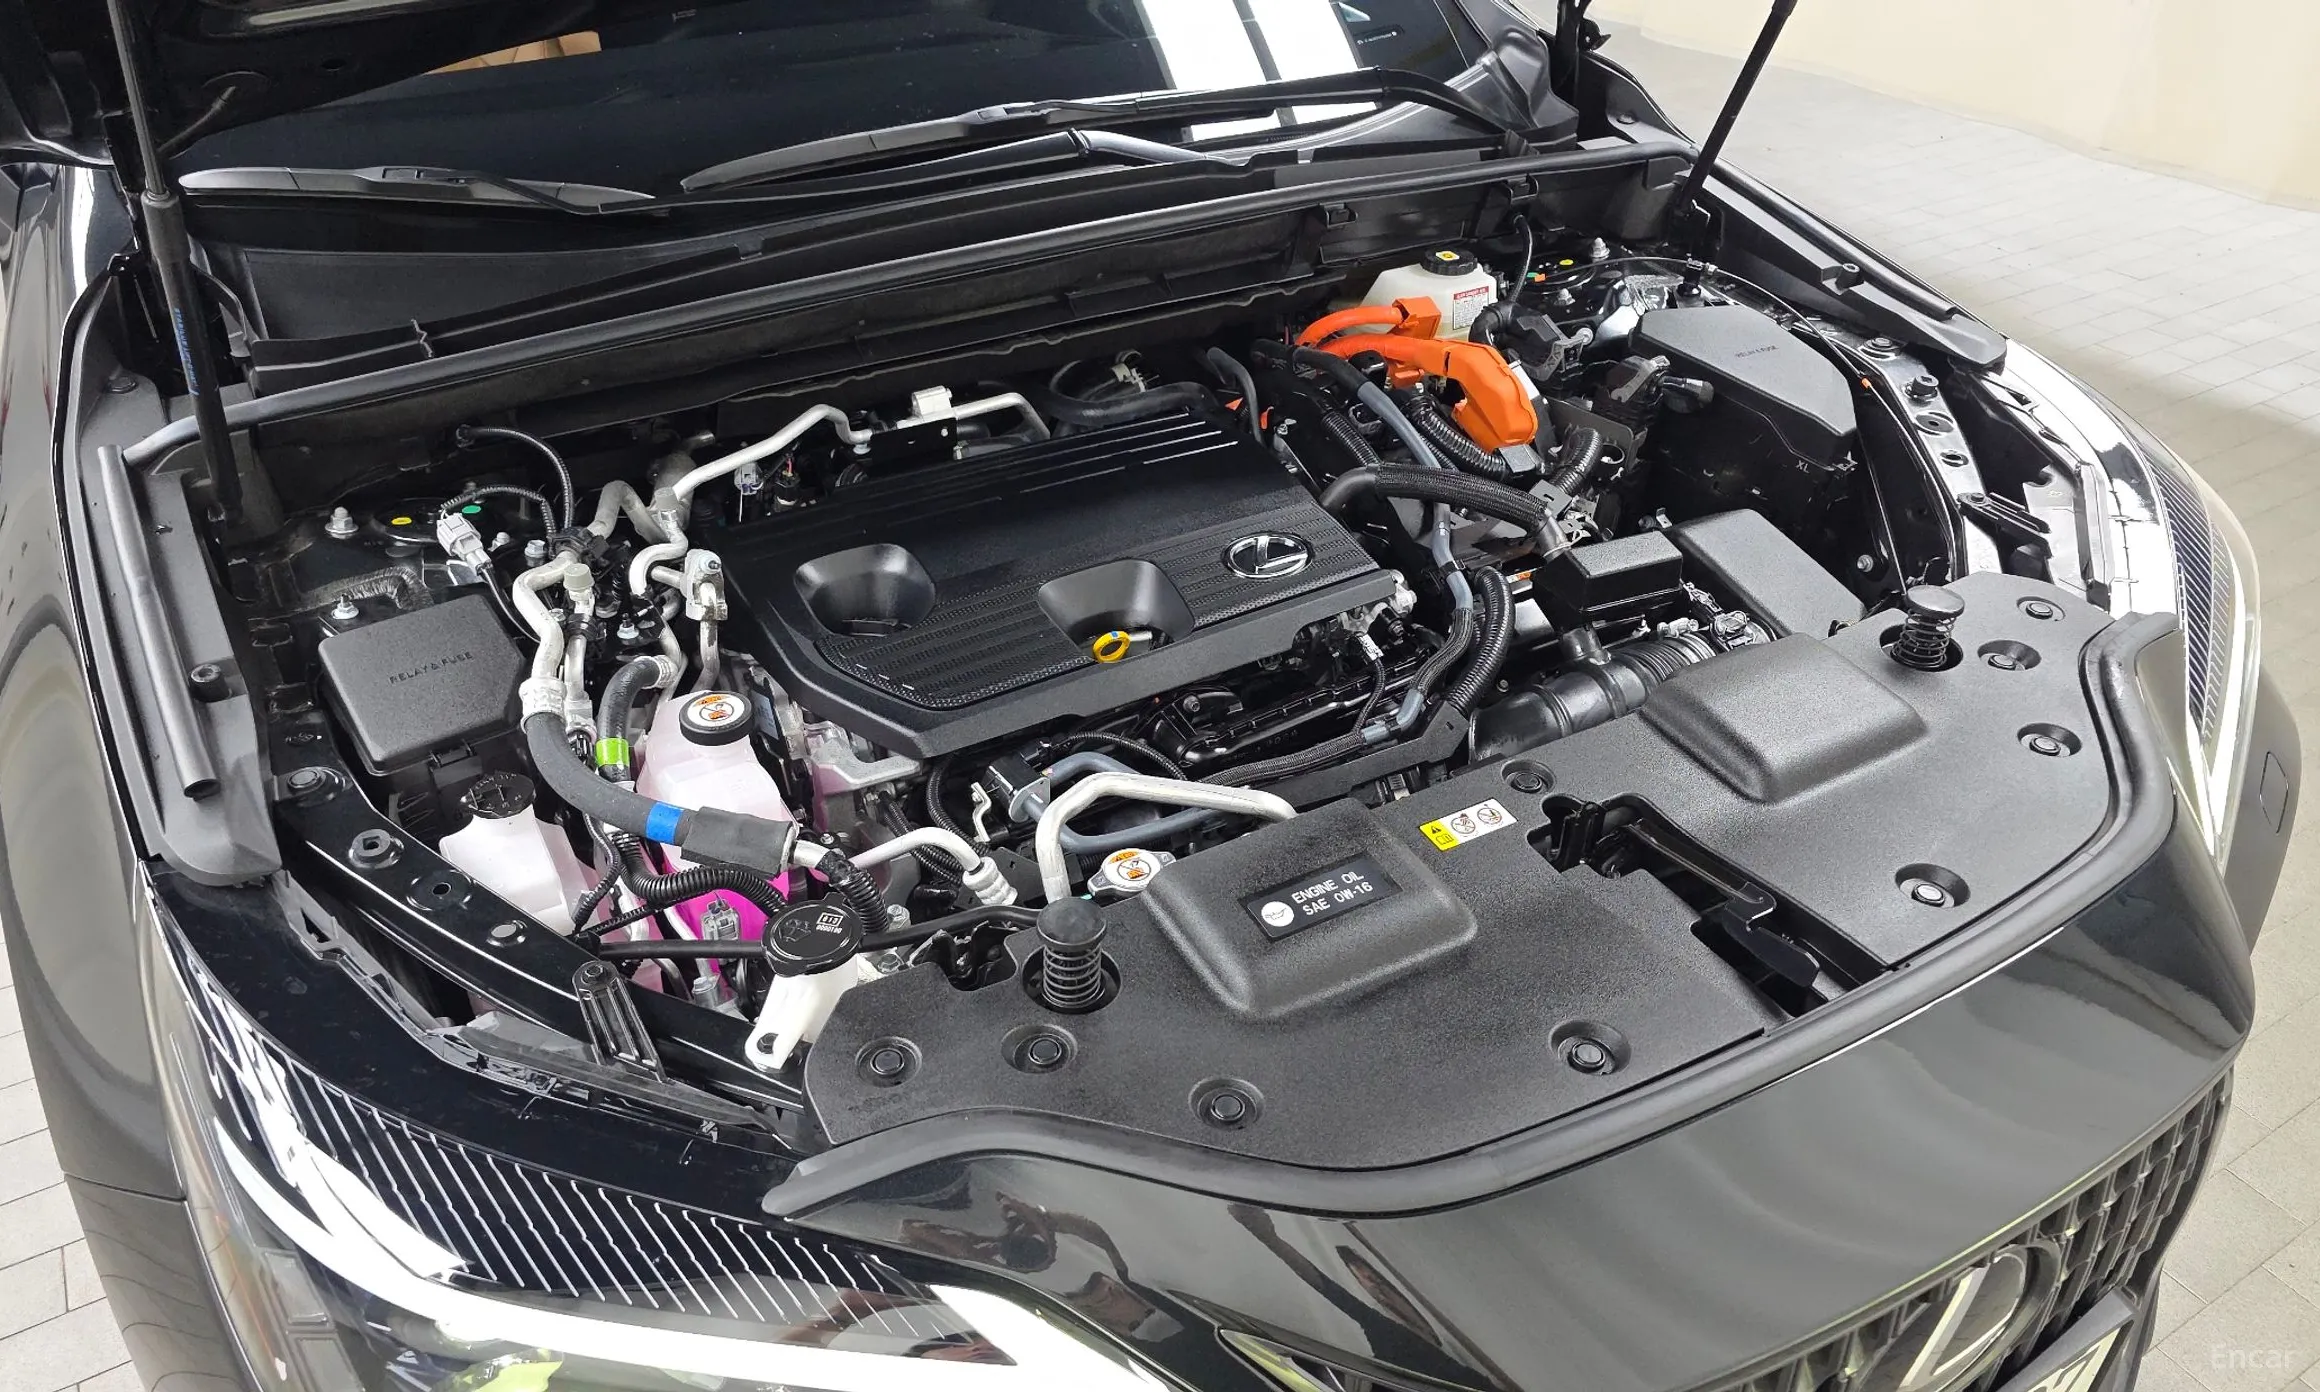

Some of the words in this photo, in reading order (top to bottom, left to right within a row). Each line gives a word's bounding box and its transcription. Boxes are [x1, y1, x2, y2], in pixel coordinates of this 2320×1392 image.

[1291, 879, 1339, 904] ENGINE
[1341, 871, 1365, 884] OIL
[1302, 897, 1331, 916] SAE
[1333, 881, 1374, 903] 0W-16
